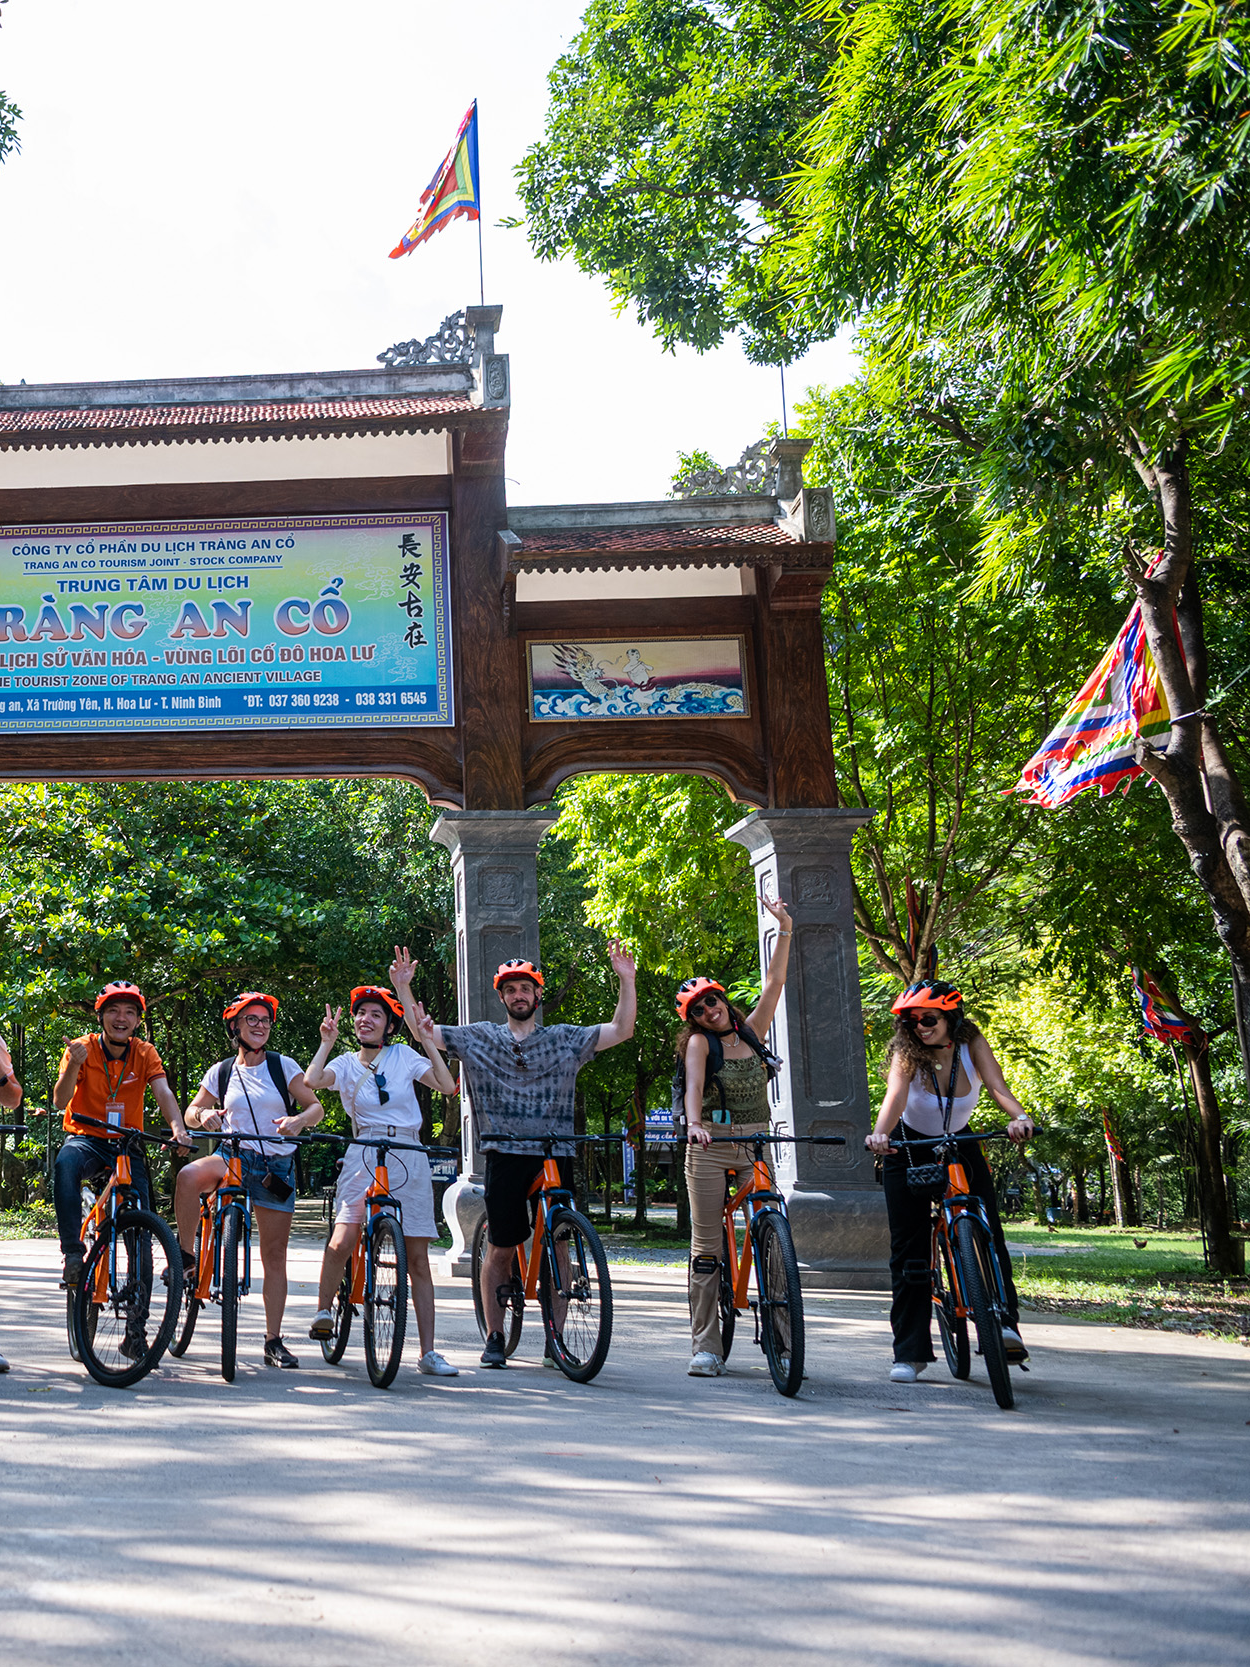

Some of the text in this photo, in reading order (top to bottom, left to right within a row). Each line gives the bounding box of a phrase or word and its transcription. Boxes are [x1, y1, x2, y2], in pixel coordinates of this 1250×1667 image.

[12, 532, 295, 556] CÔNG TY CỔ PHẦN DU LỊCH TRÀNG AN CỔ
[23, 561, 59, 570] TRANG
[62, 560, 78, 569] AN
[81, 560, 96, 568] CO
[99, 559, 146, 568] TOURISM
[149, 557, 180, 567] JOINT
[189, 556, 225, 566] STOCK
[228, 555, 283, 565] COMPANY
[57, 575, 249, 593] TRUNG TÂM DU LỊCH
[169, 600, 252, 640] AN
[275, 577, 351, 637] CỔ
[0, 653, 38, 671] LỊCH
[43, 647, 69, 667] SỬ
[71, 649, 106, 667] VĂN
[112, 649, 147, 666] HÓA
[165, 648, 212, 665] VÙNG
[217, 646, 245, 663] LÕI
[250, 643, 277, 662] CỐ
[280, 645, 304, 662] ĐÔ
[309, 647, 346, 662] HOA
[351, 644, 376, 661] LƯ
[14, 676, 69, 687] TOURIST
[72, 675, 107, 686] ZONE
[110, 674, 128, 685] OF
[132, 673, 176, 685] TRANG
[180, 673, 200, 684] AN
[203, 672, 262, 684] ANCIENT
[266, 671, 322, 682] VILLAGE
[8, 701, 24, 713] an,
[26, 698, 39, 711] Xã
[42, 698, 76, 712] Trường
[79, 697, 101, 712] Yên,
[104, 698, 114, 710] H.
[117, 697, 136, 710] Hoa
[139, 697, 152, 710] Lư
[161, 697, 169, 709] T.
[171, 696, 195, 709] Ninh
[198, 695, 221, 708] Bình
[269, 694, 288, 707] 037
[291, 694, 311, 707] 360
[313, 693, 339, 706] 9238
[355, 692, 375, 705] 038
[378, 692, 397, 705] 331
[400, 692, 427, 705] 6545
